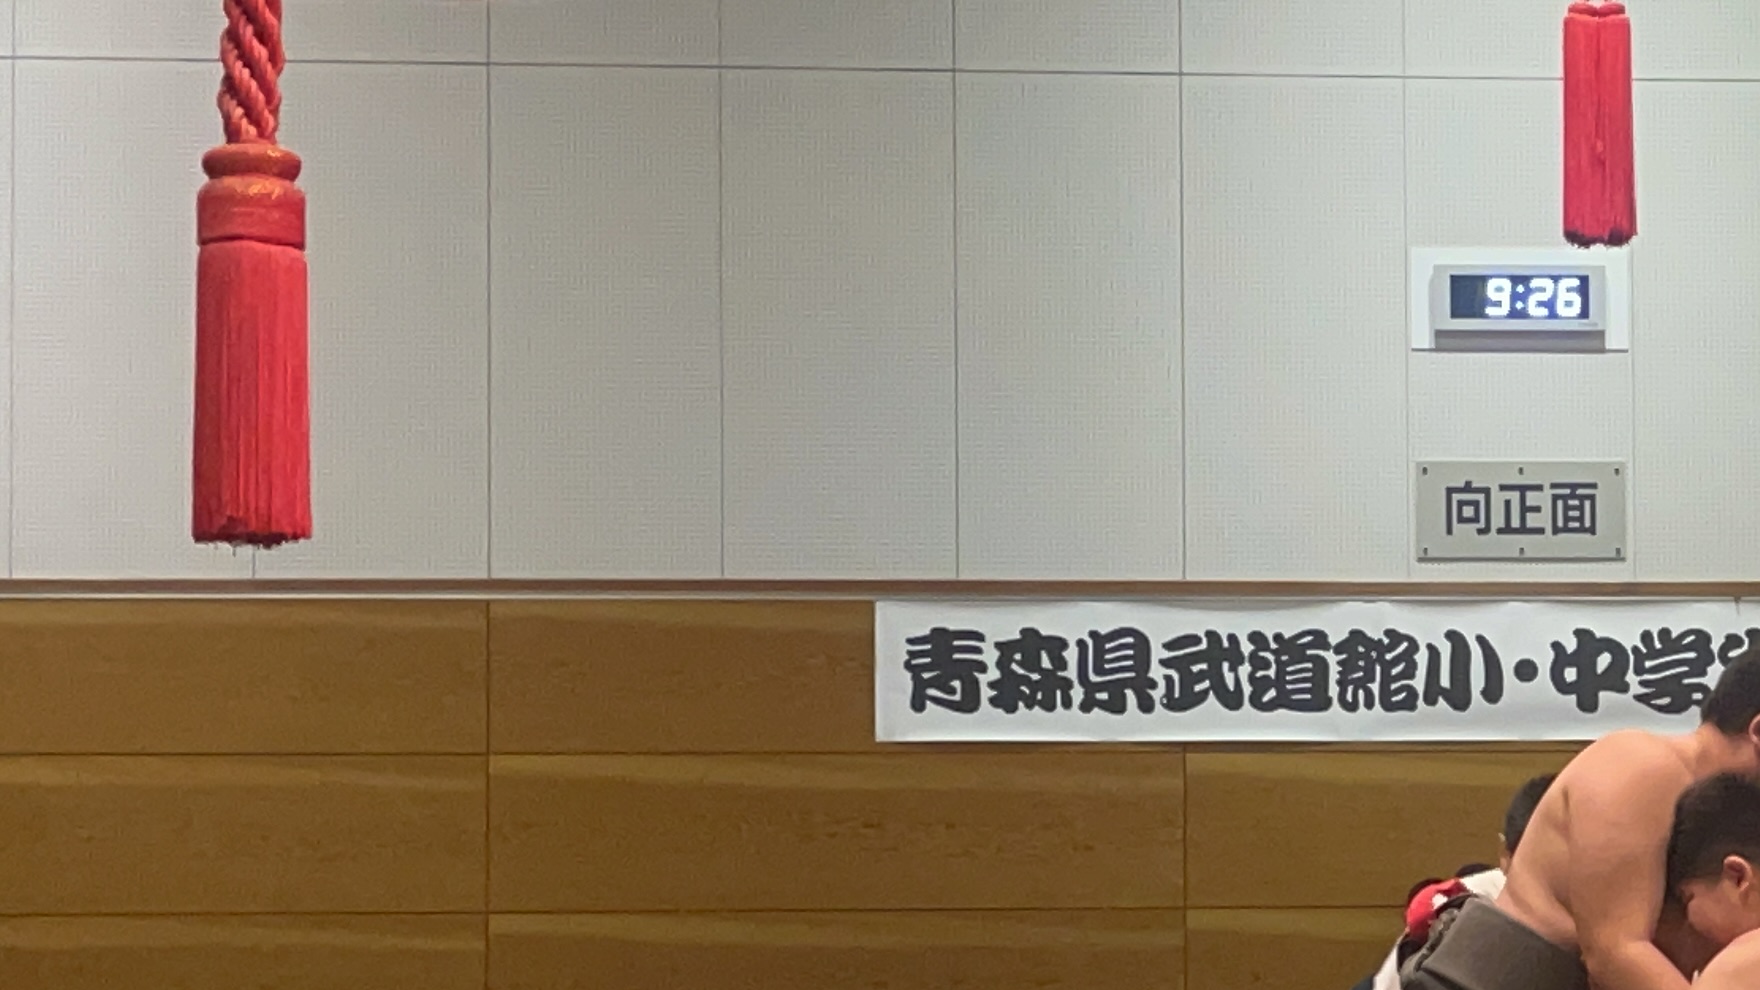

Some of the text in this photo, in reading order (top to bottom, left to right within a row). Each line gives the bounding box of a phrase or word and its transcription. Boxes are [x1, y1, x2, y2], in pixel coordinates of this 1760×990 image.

[1485, 277, 1582, 317] 9:26
[1445, 481, 1598, 536] 向正面
